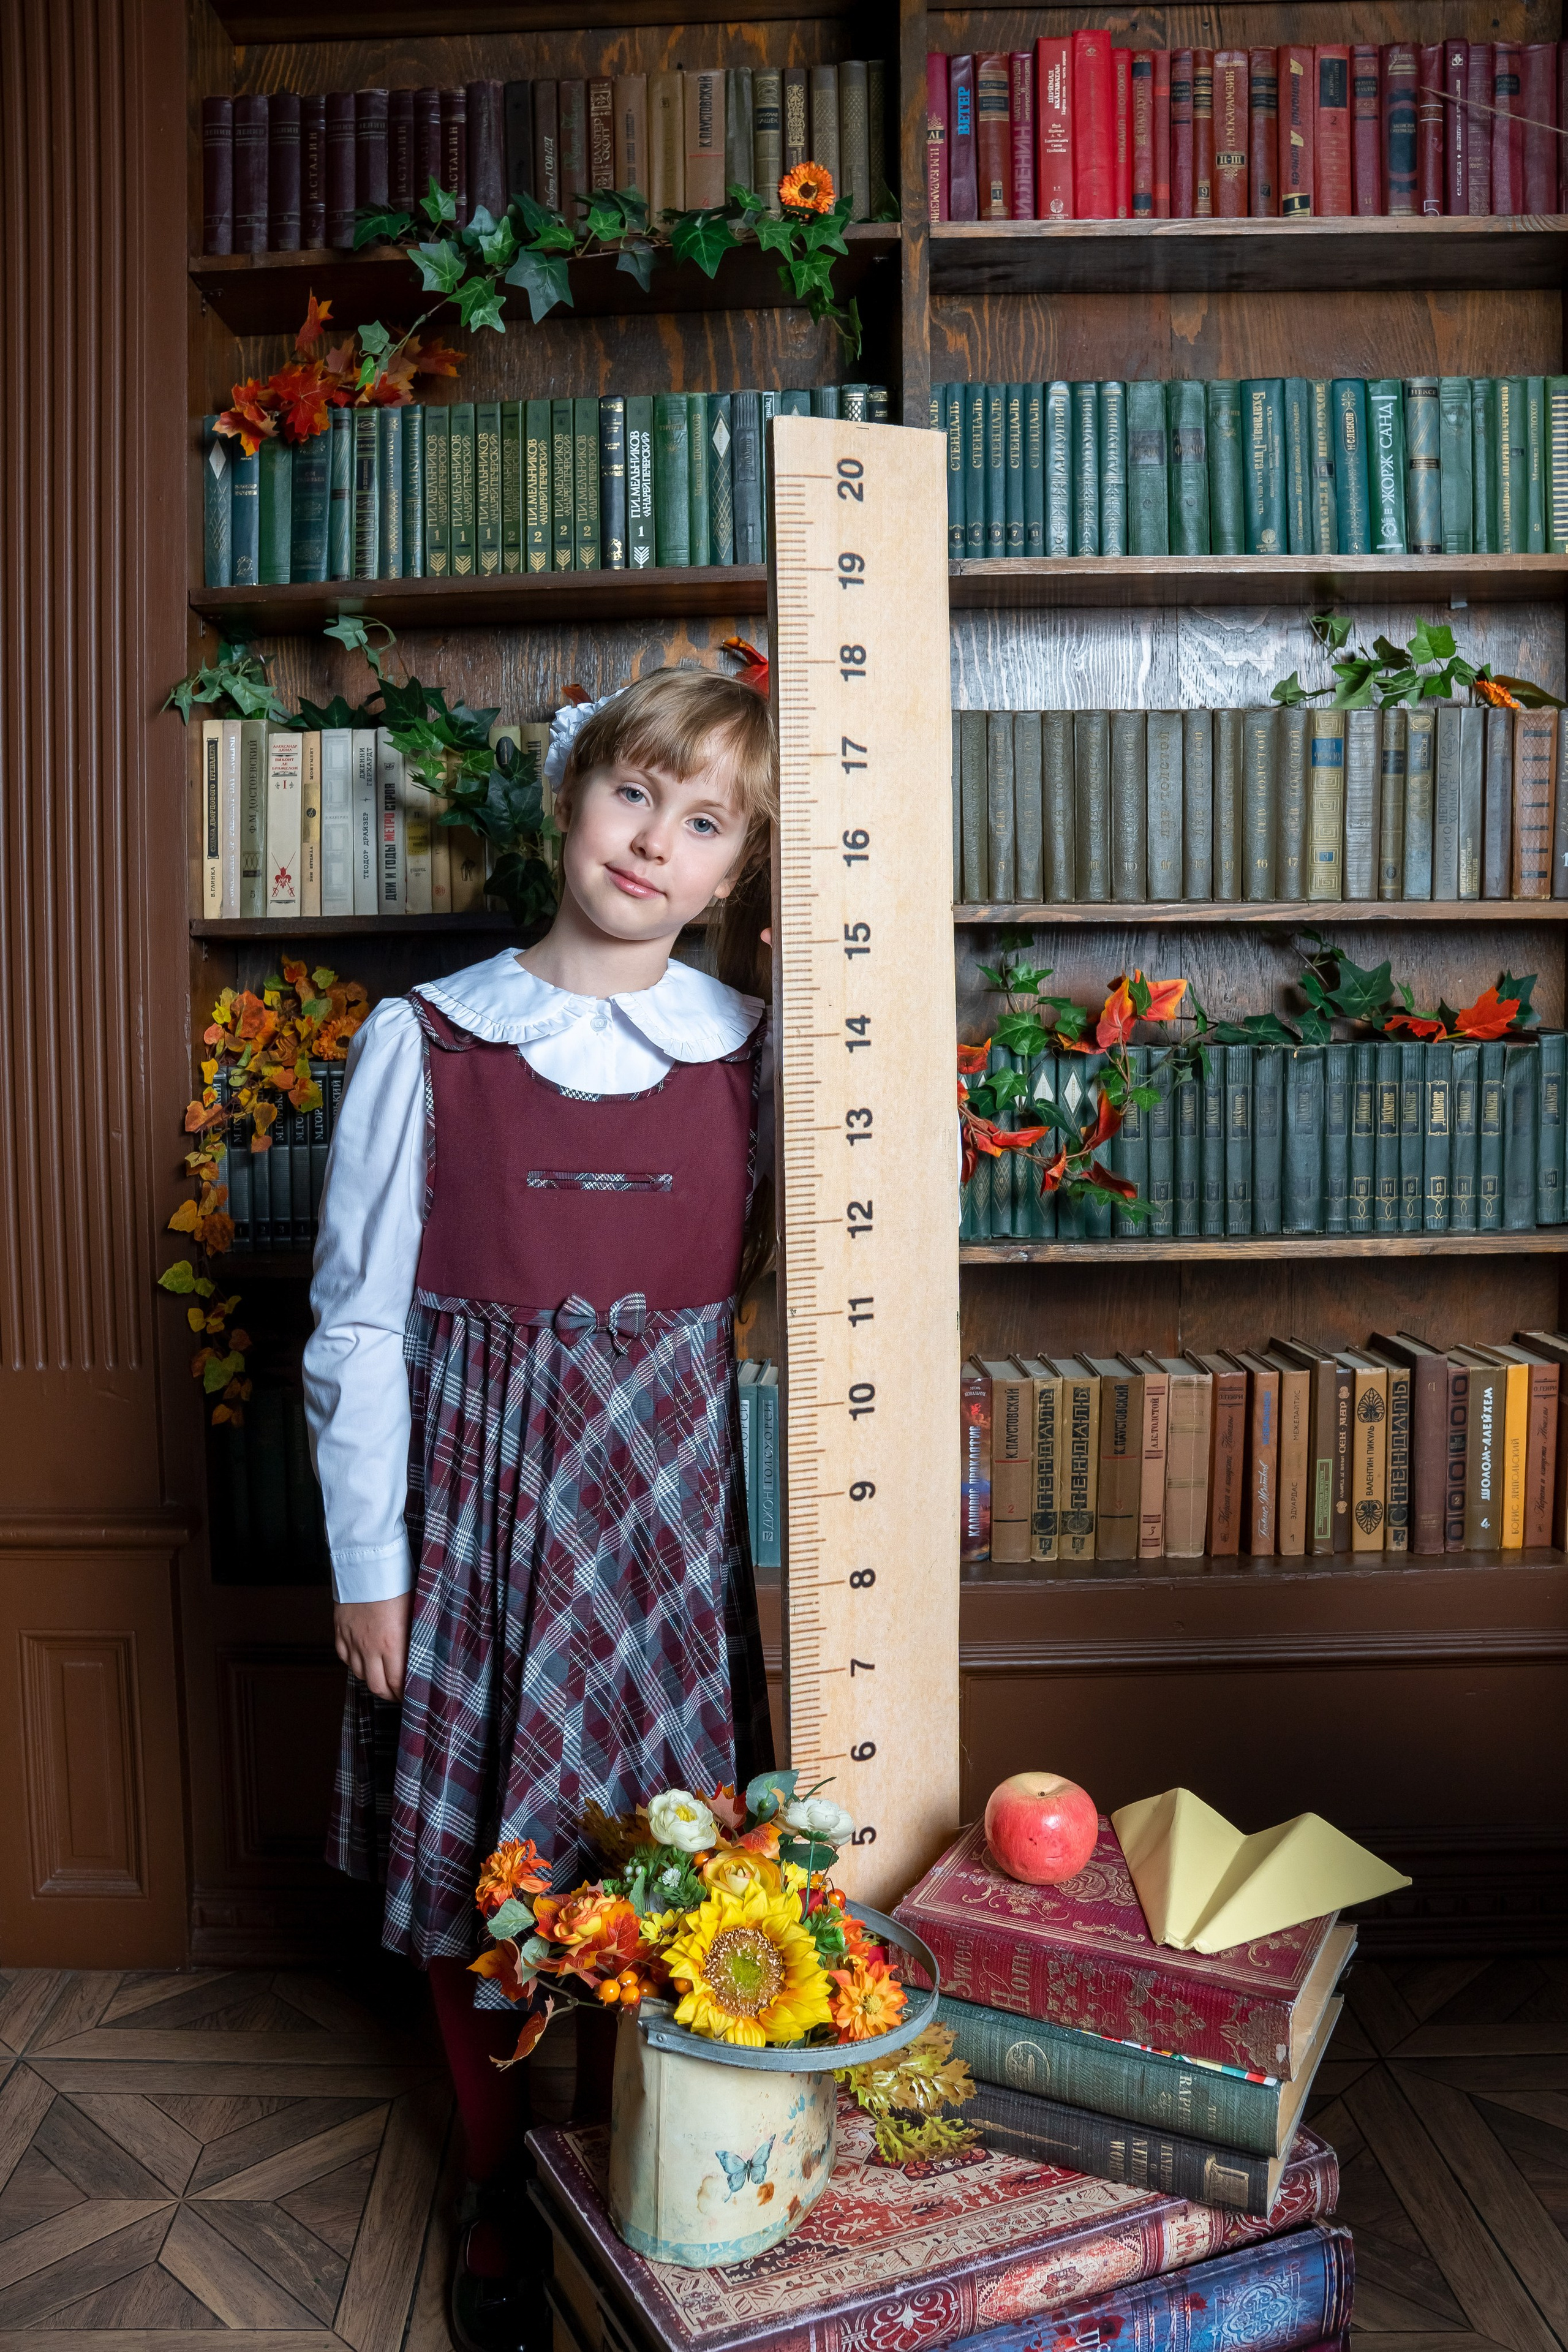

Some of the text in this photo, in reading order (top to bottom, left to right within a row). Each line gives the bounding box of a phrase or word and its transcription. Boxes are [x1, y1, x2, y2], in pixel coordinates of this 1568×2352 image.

[698, 75, 712, 148] К.ПАУСТОВСКИЙ
[957, 86, 970, 136] ВЕТЕР
[1117, 64, 1127, 163] МИХАИЛ ШОЛОХОВ
[1226, 70, 1235, 146] Н.М.КАРАМЗИН
[1289, 58, 1305, 186] Анатолий Ананьев
[1330, 116, 1337, 125] 2
[594, 118, 605, 164] ВАЛЬТЕР
[309, 132, 318, 200] И.СТАЛИН
[930, 148, 940, 222] Н.М.КАРАМЗИН
[1201, 187, 1208, 197] 9
[1423, 200, 1441, 216] 5
[693, 413, 703, 461] ШОЛОХОВ
[949, 400, 961, 472] СТЕНДАЛЬ
[972, 398, 982, 469] СТЕНДАЛЬ
[991, 398, 1001, 469] СТЕНДАЛЬ
[1009, 398, 1020, 469] СТЕНДАЛЬ
[1030, 398, 1039, 469] СТЕНДАЛЬ
[427, 434, 437, 504] МЕЛЬНИКОВ
[451, 434, 462, 504] МЕЛЬНИКОВ
[478, 433, 489, 502] МЕЛЬНИКОВ
[527, 438, 538, 505] МЕЛЬНИКОВ
[554, 434, 564, 496] МЕЛЬНИКОВ
[578, 434, 587, 500] МЕЛЬНИКОВ
[630, 430, 641, 497] МЕЛЬНИКОВ
[1379, 402, 1395, 504] ЖОРЖ САНД
[837, 458, 865, 502] 20
[434, 529, 440, 541] 1
[459, 530, 466, 542] 1
[485, 528, 492, 540] 1
[508, 530, 516, 541] 2
[533, 531, 543, 543] 2
[560, 524, 568, 536] 2
[583, 525, 592, 537] 2
[638, 525, 645, 537] 1
[839, 553, 865, 589] 19
[840, 645, 867, 681] 18
[842, 737, 868, 774] 17
[1439, 774, 1449, 824] ШЕРЛОКЕ
[843, 830, 870, 867] 16
[1443, 826, 1452, 891] ЗАПИСКИ О
[385, 844, 398, 901] ДНИ И ГОДЫ
[844, 922, 871, 960] 15
[845, 1015, 872, 1053] 14
[1234, 1094, 1246, 1129] Диккенс
[1355, 1091, 1371, 1126] Диккенс
[1381, 1091, 1396, 1127] Диккенс
[1403, 1091, 1417, 1126] Диккенс
[1431, 1091, 1446, 1127] Диккенс
[1458, 1090, 1472, 1125] Диккенс
[1483, 1091, 1498, 1127] Диккенс
[1547, 1082, 1559, 1118] Диккенс
[845, 1108, 873, 1146] 13
[1159, 1187, 1165, 1196] 2
[1359, 1183, 1366, 1193] 10
[1385, 1183, 1392, 1193] 11
[1407, 1182, 1414, 1193] 12
[1436, 1182, 1443, 1192] 13
[1461, 1182, 1468, 1191] 14
[846, 1200, 873, 1238] 12
[848, 1297, 875, 1327] 11
[848, 1383, 876, 1421] 10
[1114, 1384, 1129, 1455] К.ПАУСТОВСКИЙ
[1292, 1390, 1301, 1441] МЕЖЕЛАЙТИС
[1005, 1387, 1020, 1460] К.ПАУСТОВСКИЙ
[1150, 1397, 1160, 1449] А.К.ТОЛСТОЙ
[1033, 1390, 1056, 1536] СТЕНДАЛЬ
[1066, 1389, 1091, 1536] СТЕНДАЛЬ
[1365, 1425, 1376, 1496] ВАЛЕНТИН ПИКУЛЬ
[1390, 1382, 1408, 1525] СТЕНДАЛЬ
[1480, 1387, 1493, 1501] ШОЛОМ-АЛЕЙХЕМ
[763, 1401, 774, 1530] ДЖОН ГОЛСУОРСИ
[968, 1425, 981, 1537] КЛАНОВОЕ ПРОКЛЯТИЕ
[849, 1481, 876, 1501] 9
[1511, 1438, 1520, 1534] БОРИС ЯМПОЛЬСКИЙ
[1008, 1504, 1015, 1514] 2
[1116, 1501, 1123, 1510] 3
[1480, 1517, 1490, 1529] 4
[1040, 1539, 1050, 1549] 12
[1148, 1526, 1156, 1536] 3
[850, 1569, 876, 1589] 8
[850, 1659, 876, 1677] 7
[850, 1741, 877, 1762] 6
[851, 1826, 877, 1845] 5
[990, 1940, 1034, 2015] Home
